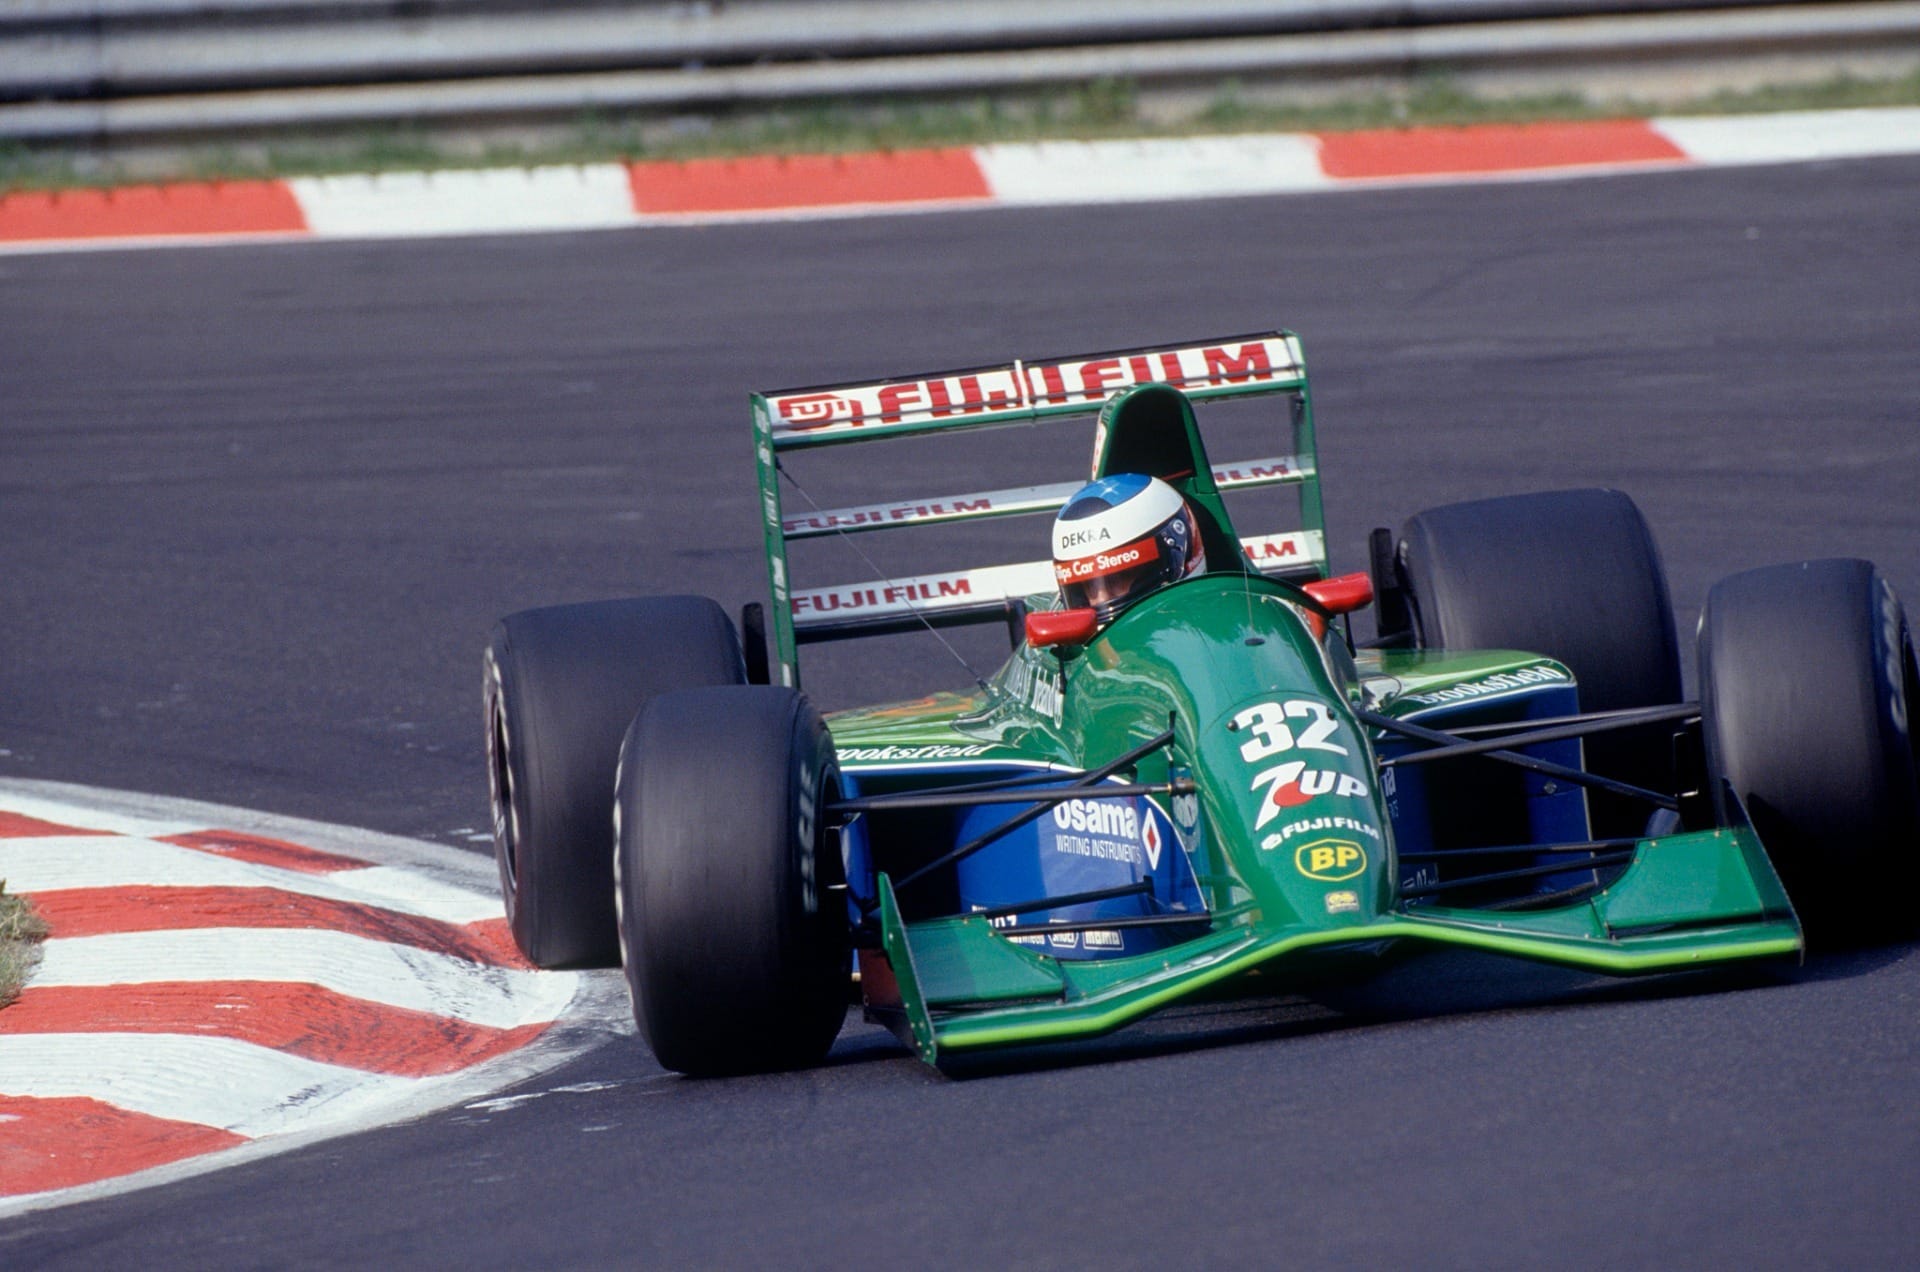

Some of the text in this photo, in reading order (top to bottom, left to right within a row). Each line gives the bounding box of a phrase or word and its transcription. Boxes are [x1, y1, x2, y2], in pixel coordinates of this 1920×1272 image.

[1214, 464, 1289, 482] ILM
[1073, 559, 1095, 577] Car
[1096, 549, 1140, 570] Stereo
[1233, 699, 1349, 763] 32
[1053, 799, 1140, 840] osama
[1056, 834, 1142, 865] WRITING INSTRUMENTS
[1310, 846, 1359, 872] BP
